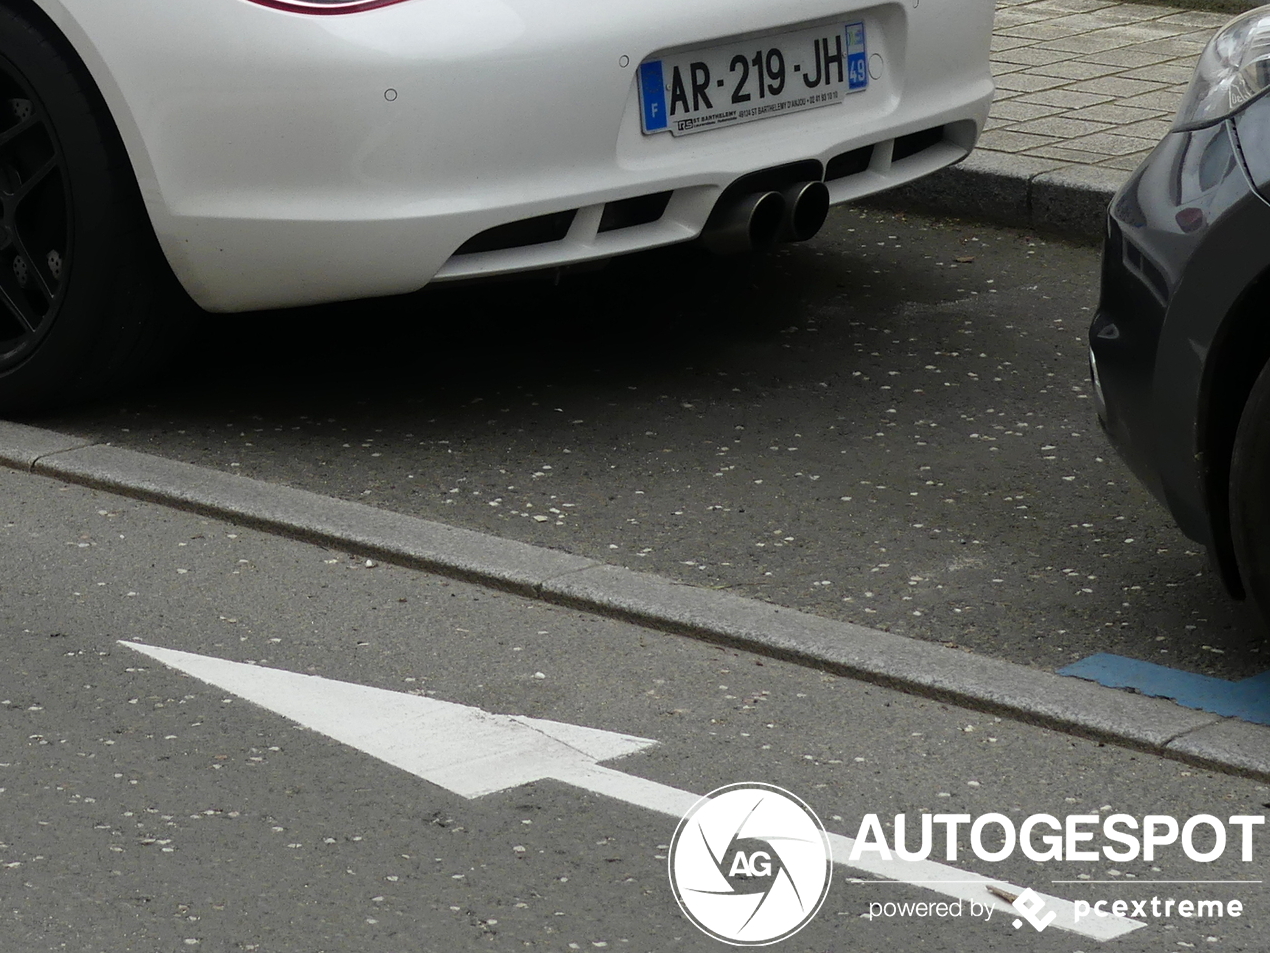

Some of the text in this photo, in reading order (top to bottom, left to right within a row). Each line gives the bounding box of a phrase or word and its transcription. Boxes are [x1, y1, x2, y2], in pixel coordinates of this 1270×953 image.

[850, 59, 864, 82] 49
[651, 103, 658, 118] F
[701, 111, 736, 122] BARTHELEMY
